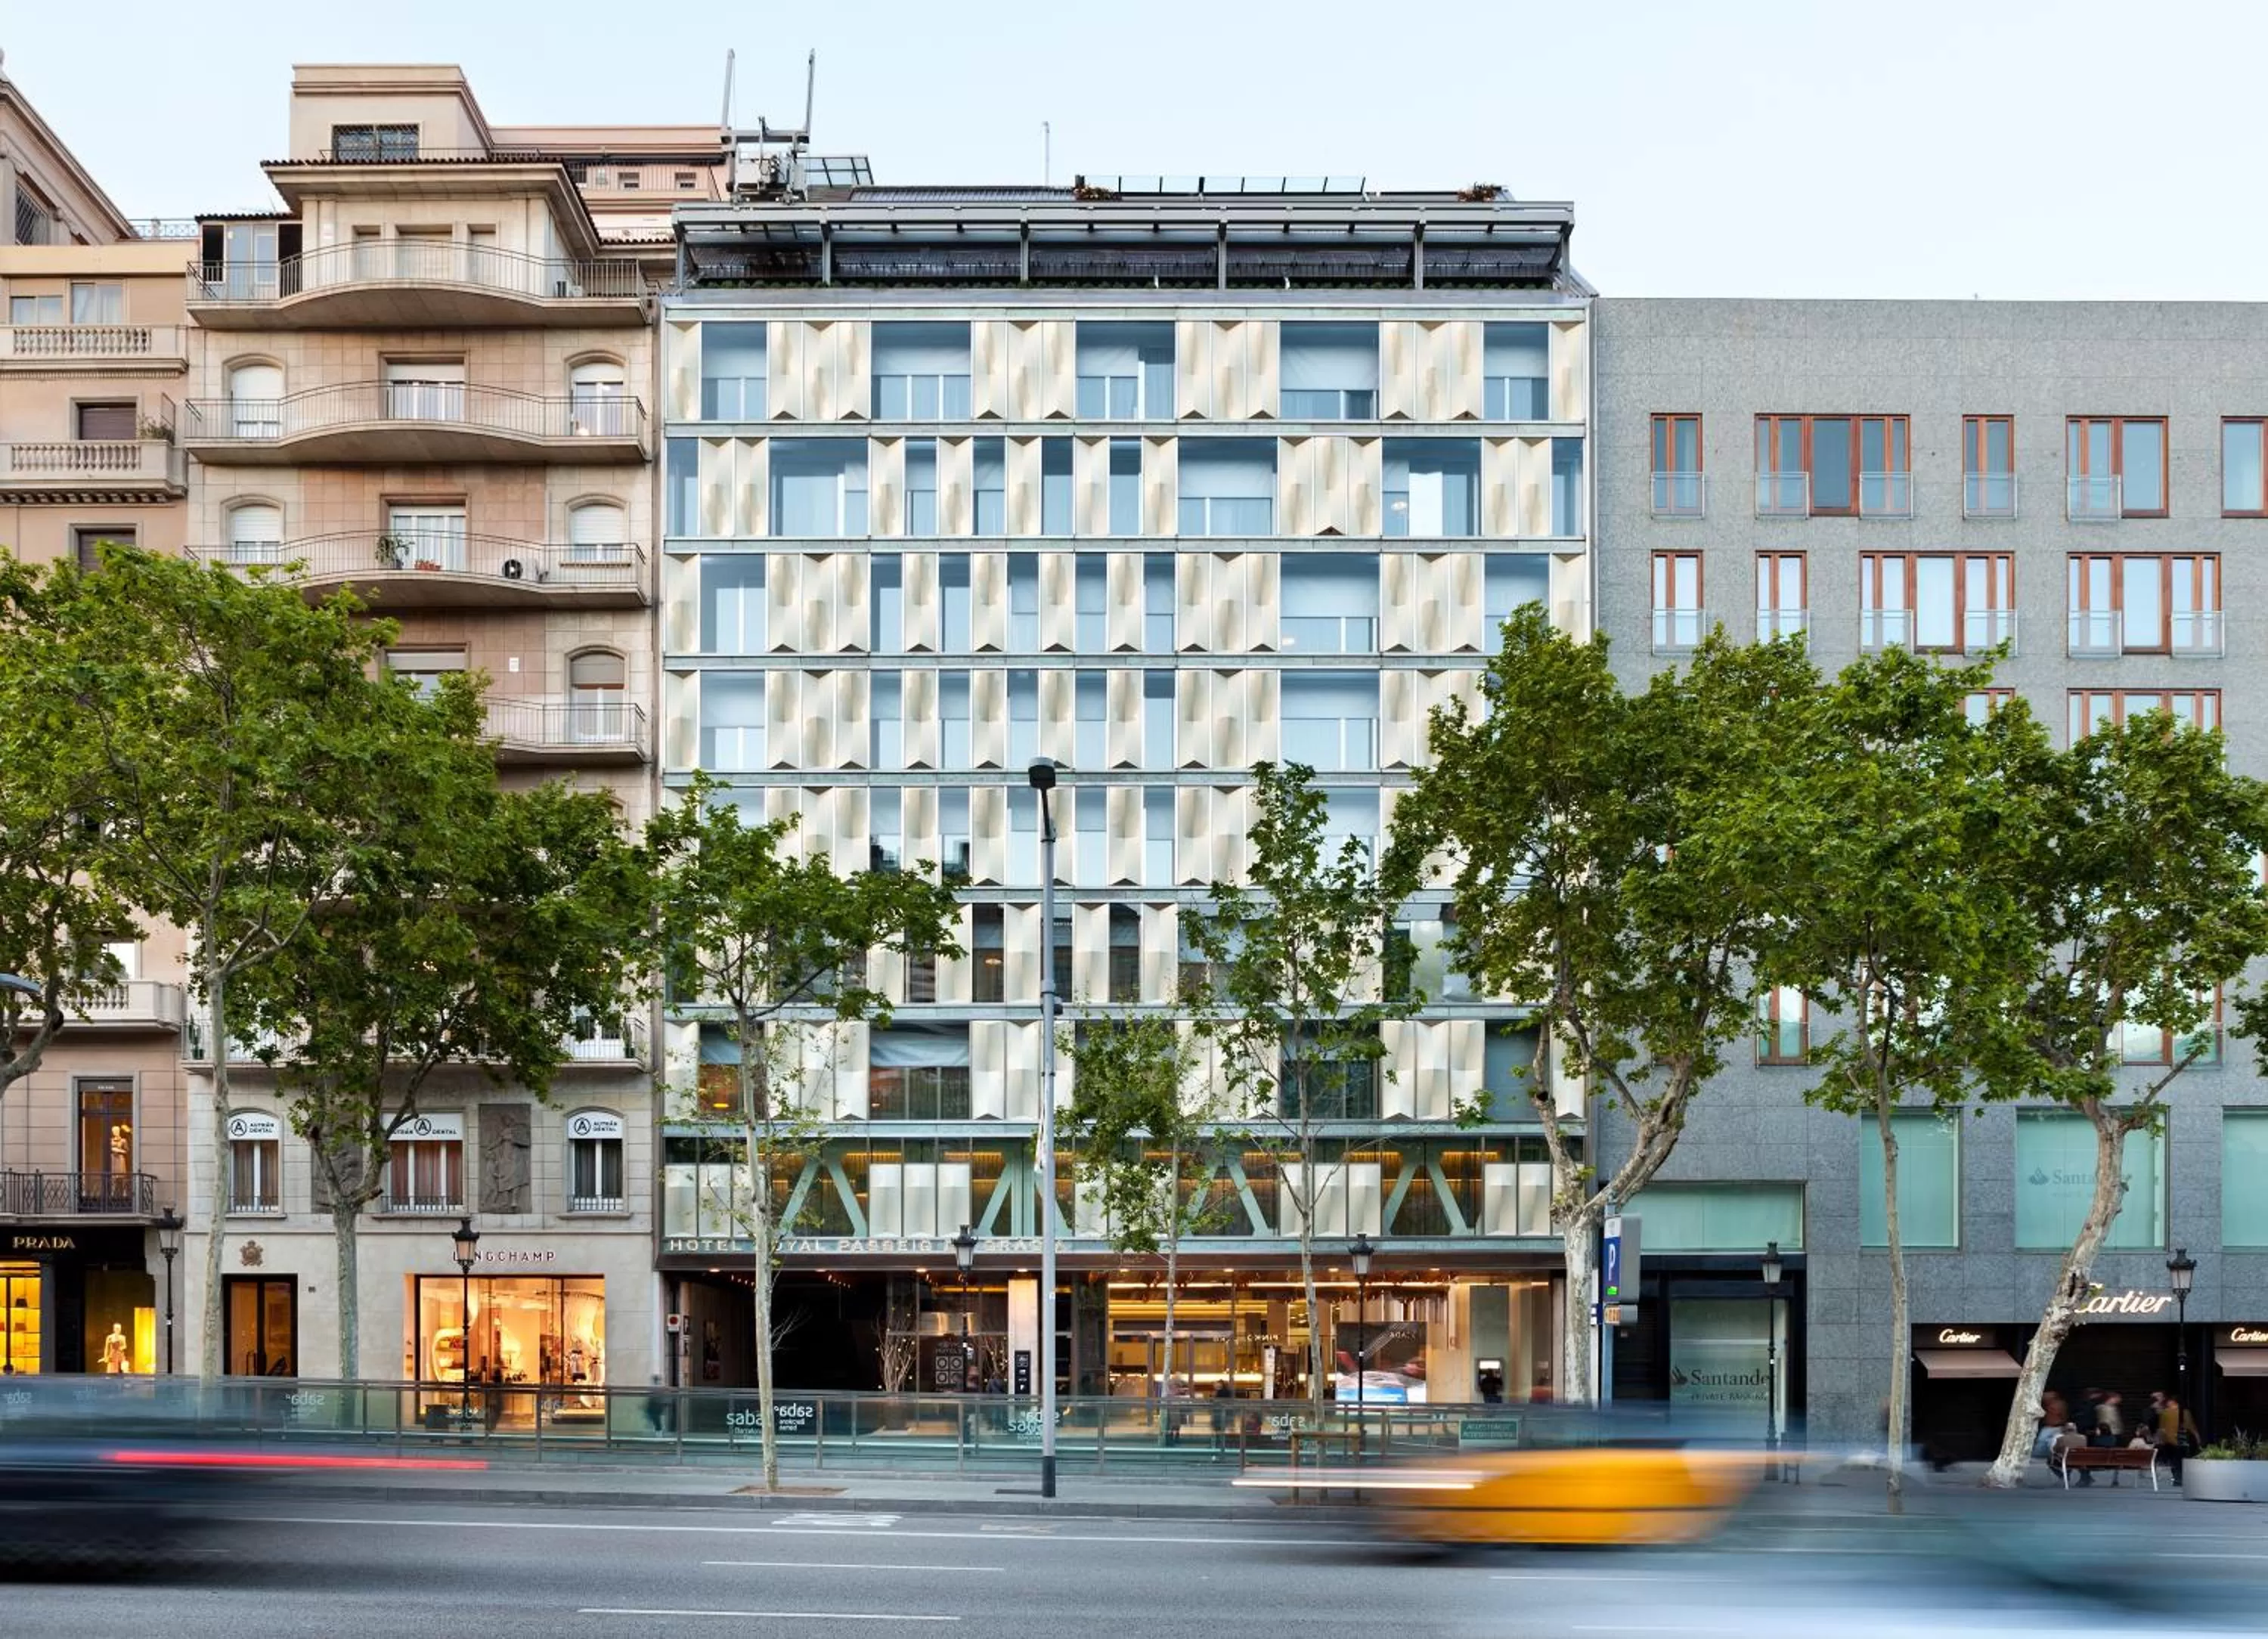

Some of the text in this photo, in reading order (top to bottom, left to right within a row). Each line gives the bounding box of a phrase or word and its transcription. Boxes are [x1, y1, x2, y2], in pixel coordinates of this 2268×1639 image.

[12, 1236, 76, 1249] PRADA
[670, 1239, 743, 1252] HOTEL
[840, 1239, 933, 1252] PASSEIG
[454, 1251, 556, 1262] LNGCHAMP
[1608, 1243, 1616, 1281] P
[1938, 1328, 1981, 1343] Cartier
[1690, 1361, 1770, 1386] Santande
